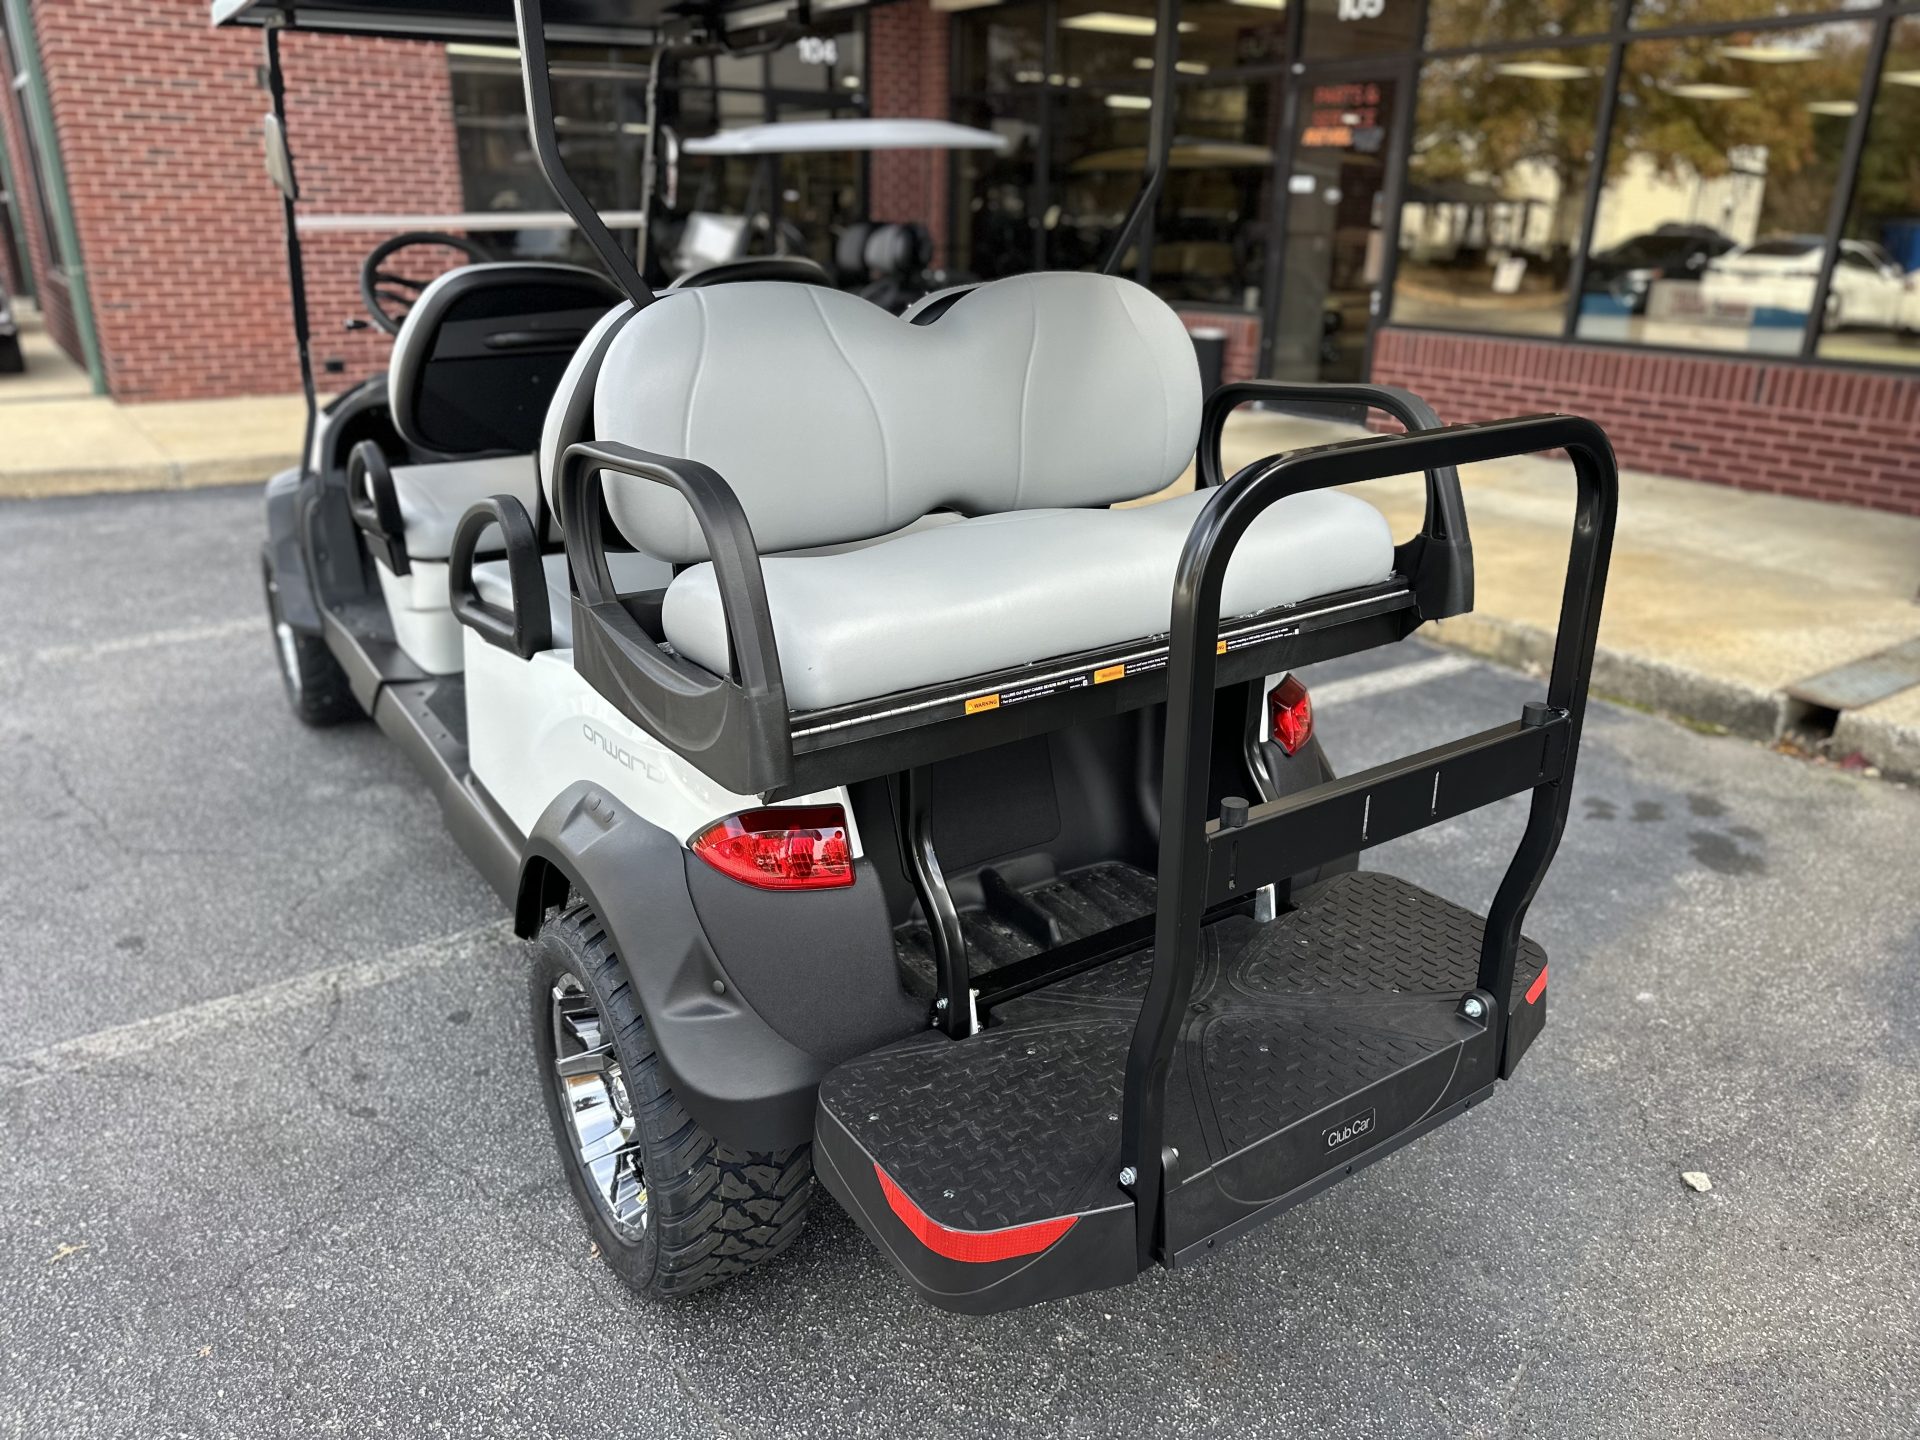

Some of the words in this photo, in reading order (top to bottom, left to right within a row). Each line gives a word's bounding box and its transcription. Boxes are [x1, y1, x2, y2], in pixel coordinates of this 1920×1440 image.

[973, 700, 998, 710] WARNING
[1328, 1126, 1352, 1147] Club
[1352, 1118, 1370, 1134] Car
